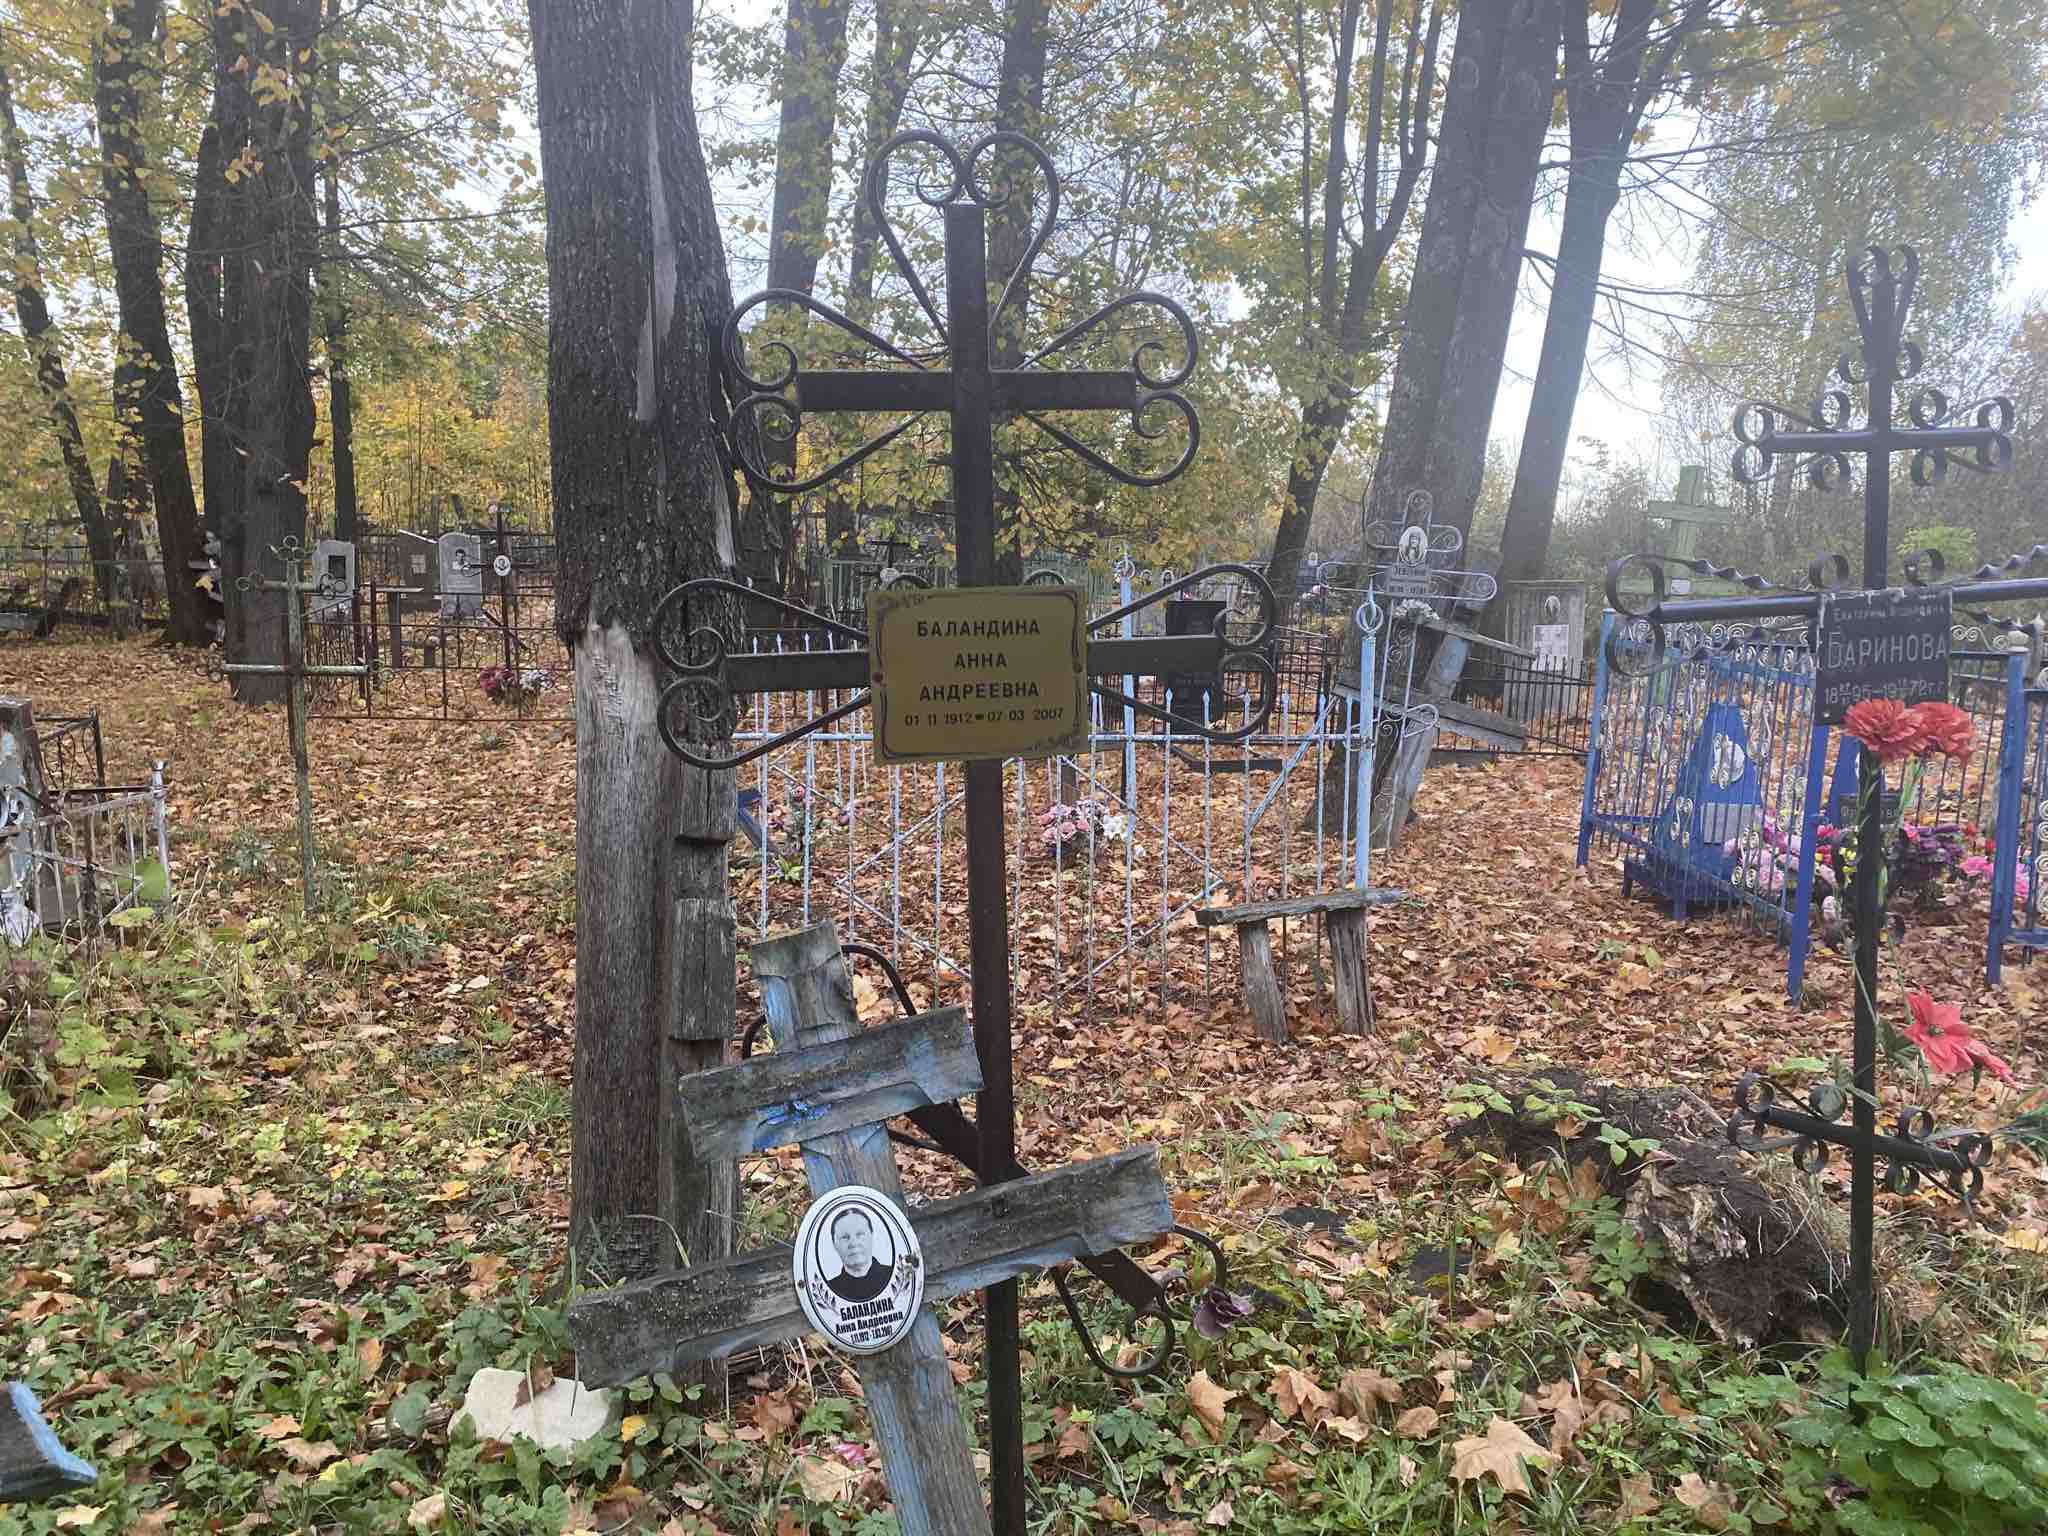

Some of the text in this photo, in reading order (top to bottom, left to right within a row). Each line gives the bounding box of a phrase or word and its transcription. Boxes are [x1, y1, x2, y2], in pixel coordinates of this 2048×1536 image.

[917, 619, 1041, 639] БАЛАНДИНА
[954, 652, 1009, 670] АННА
[919, 683, 1040, 703] АНДРЕЕВНА
[840, 1297, 894, 1322] БАЛАНДИНА
[835, 1311, 904, 1335] Анна Андреевна
